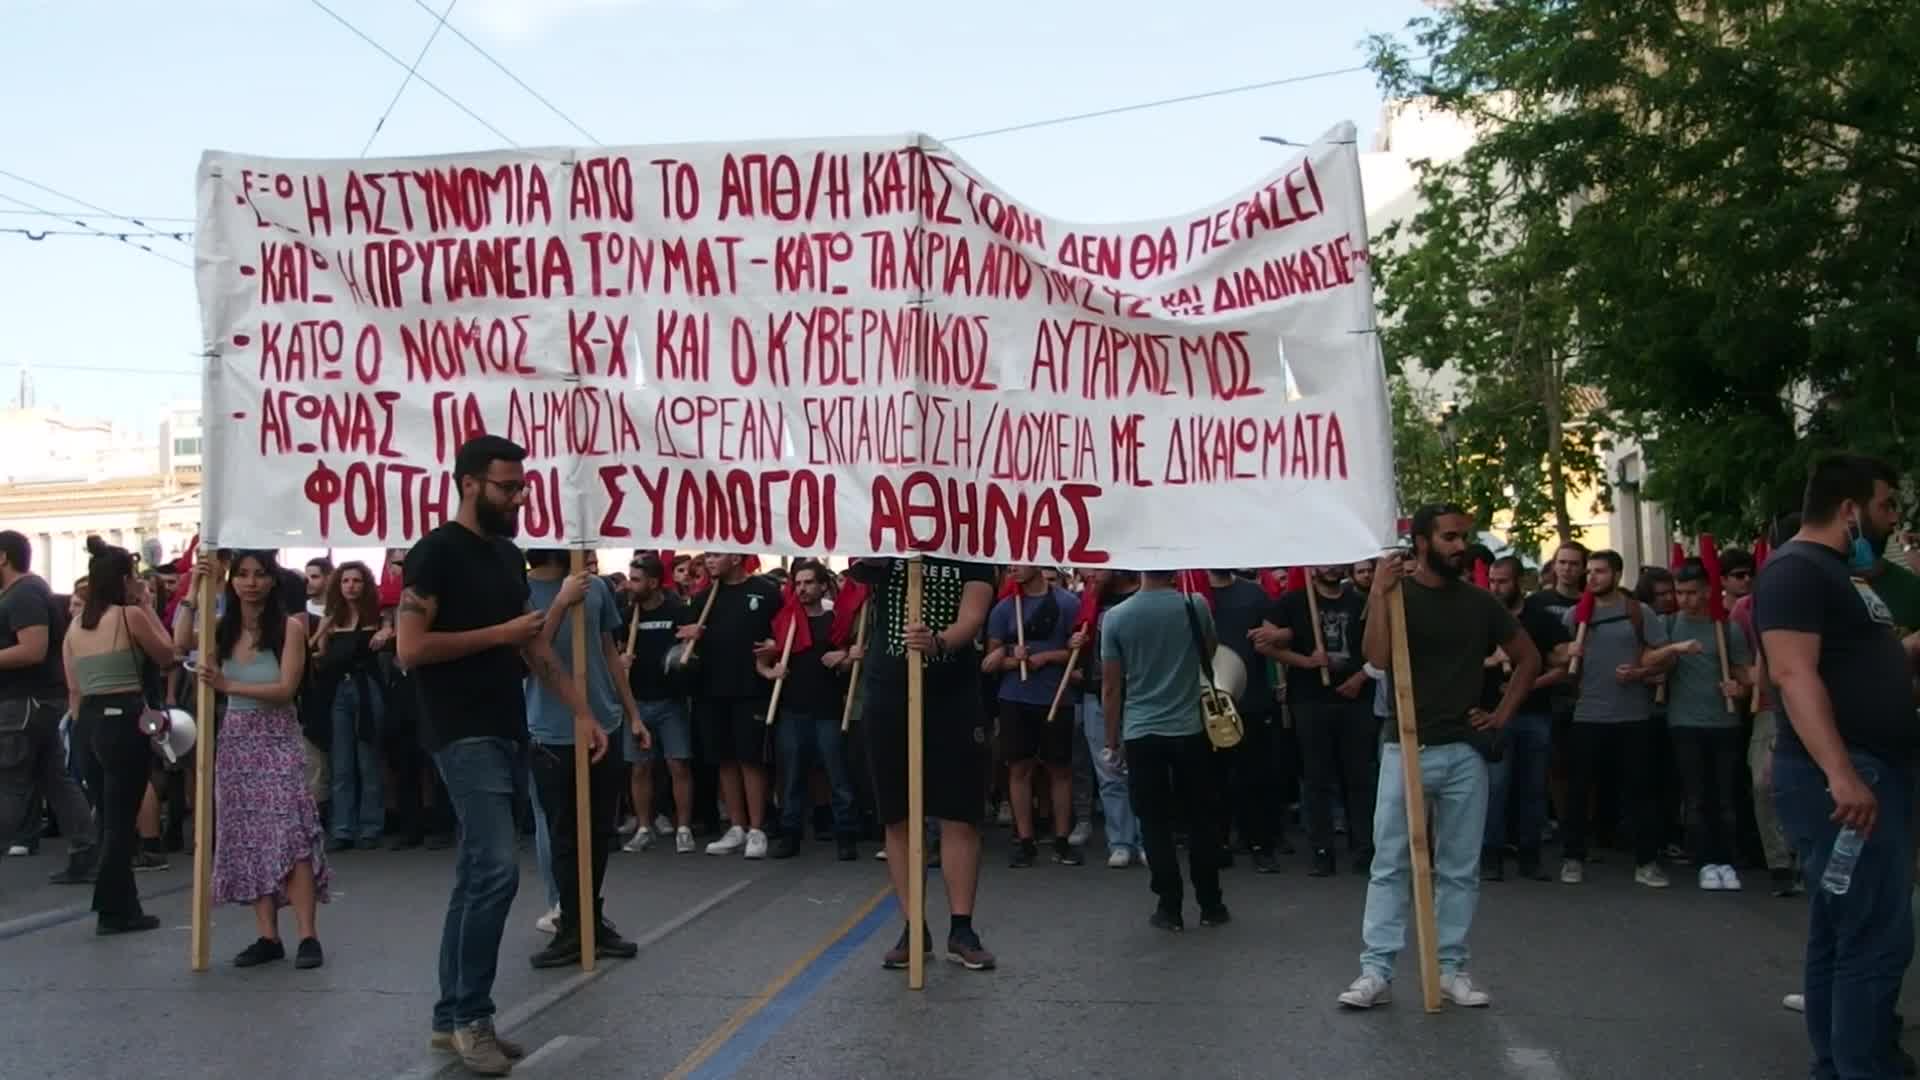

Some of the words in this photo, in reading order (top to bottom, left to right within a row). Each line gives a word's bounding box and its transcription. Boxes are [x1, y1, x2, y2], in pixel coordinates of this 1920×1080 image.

[303, 174, 331, 237] Η
[345, 164, 552, 235] ΑΣΤΥΝΟΜΙΑ
[570, 157, 632, 222] ΑΠΟ
[651, 158, 699, 222] ΤΟ
[863, 146, 1046, 250] ΚΑΤΑΣΤΟΛΗ
[1058, 231, 1121, 280] ΔΕΝ
[1128, 226, 1177, 280] ΘΑ
[1186, 157, 1324, 263] ΠΕΡΑΣΕΙ
[261, 241, 333, 305] ΚΑΤΩ
[364, 236, 574, 307] ΠΡΥΤΑΝΕΙΑ
[582, 232, 654, 296] ΤΩΝ
[661, 234, 745, 296] ΜΑΤ
[774, 231, 854, 296] ΚΑΤΩ
[861, 231, 897, 291] ΤΑ
[902, 226, 972, 297] ΧΡΙΑ
[975, 243, 1031, 300] ΑΠΟ
[1160, 285, 1201, 308] ΚΑΙ
[260, 320, 343, 381] ΚΑΤΩ
[355, 324, 382, 385] Ο
[399, 315, 537, 381] ΝΟΜΟΣ
[568, 310, 630, 377] Κ-Χ
[656, 309, 710, 381] ΚΑΙ
[731, 317, 757, 386] Ο
[769, 306, 998, 390] ΚΥΒΕΡΝΗΤΙΚΟΣ
[1031, 319, 1265, 400] ΑΥΤΑΡΧΙΣΜΟΣ
[260, 388, 404, 457] ΑΓΩΝΑΣ
[433, 391, 488, 464] ΓΙΑ
[508, 387, 640, 459] ΔΗΜΟΣΙΑ
[654, 396, 782, 461] ΔΩΡΕΑΝ
[1111, 414, 1152, 487] ΜΕ
[1163, 411, 1348, 484] ΔΙΚΑΙΩΜΑΤΑ
[598, 464, 837, 553] ΣΥΛΛΟΓΟΙ
[869, 470, 1109, 563] ΑΘΗΝΑΣ
